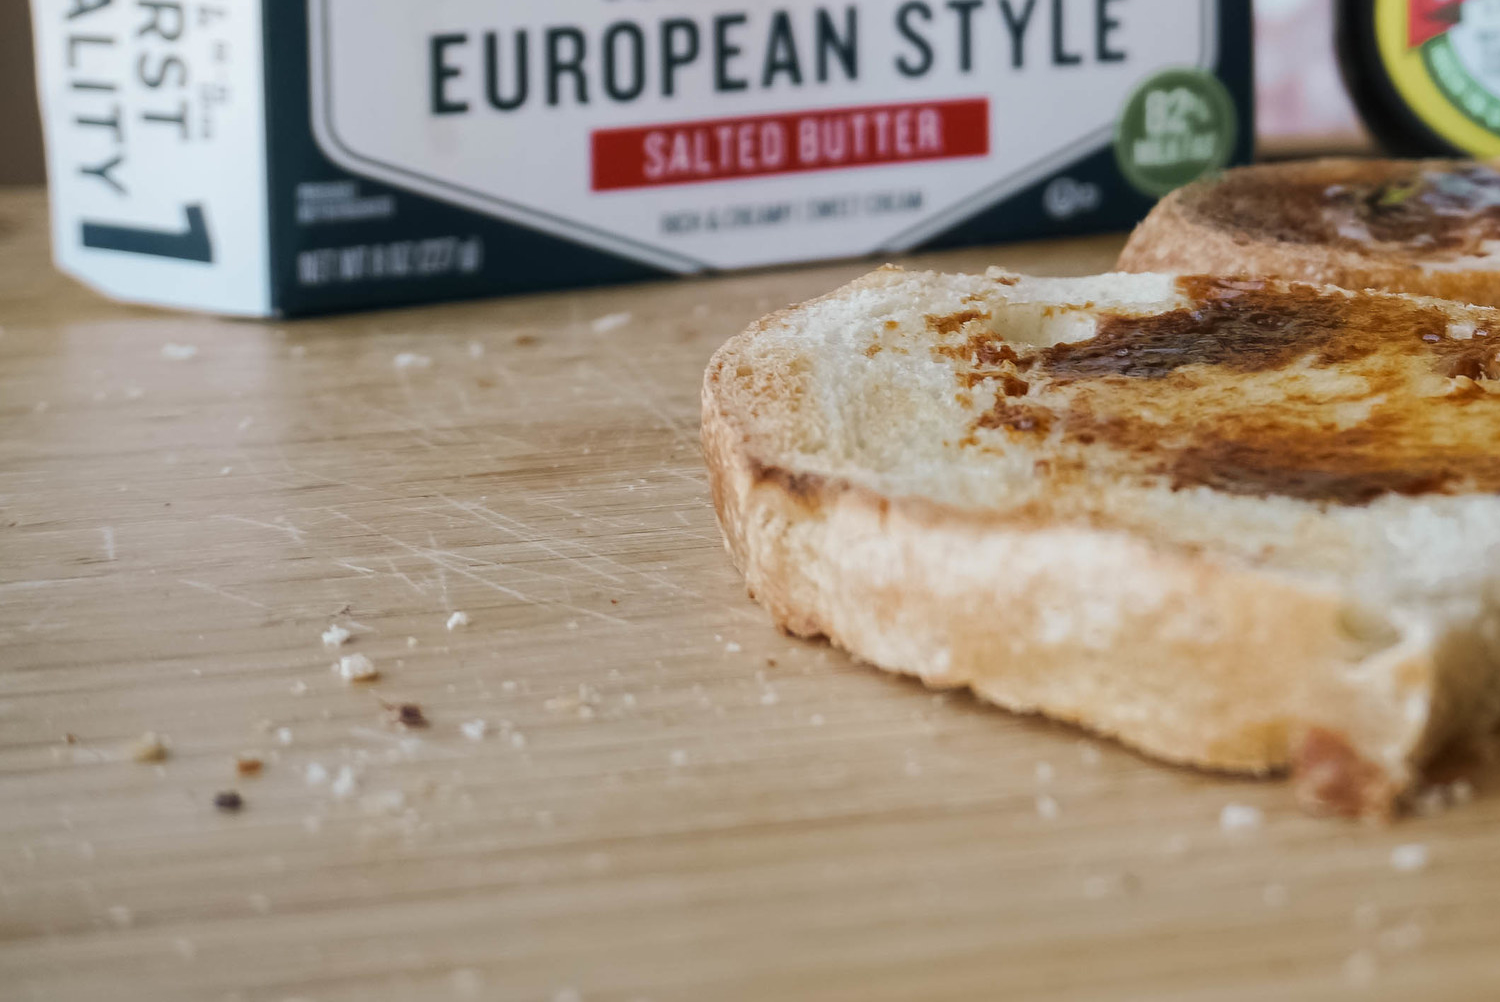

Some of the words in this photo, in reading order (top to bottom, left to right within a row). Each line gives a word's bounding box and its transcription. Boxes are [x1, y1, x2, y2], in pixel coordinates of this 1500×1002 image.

[429, 3, 859, 117] EUROPEAN
[643, 120, 788, 179] SALTED
[799, 107, 944, 163] BUTTER
[80, 203, 216, 264] 1
